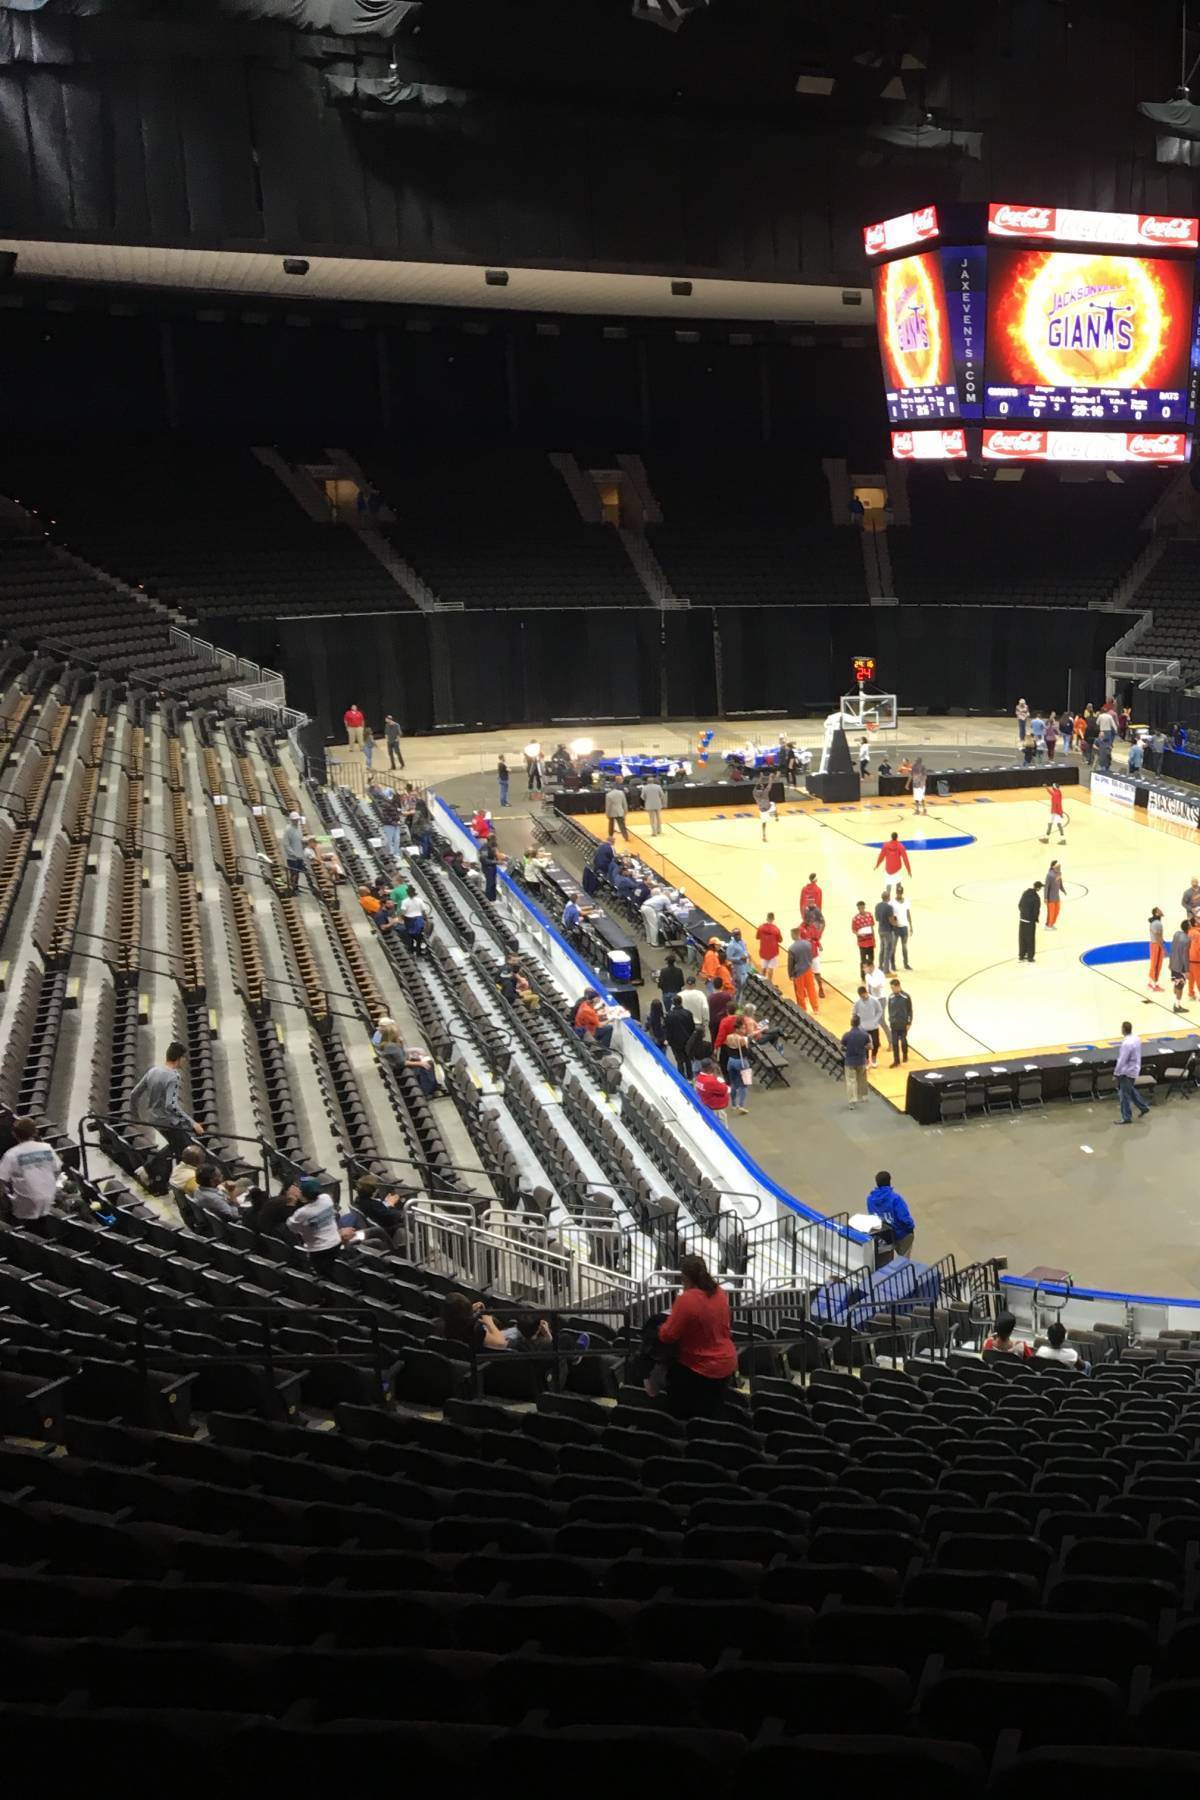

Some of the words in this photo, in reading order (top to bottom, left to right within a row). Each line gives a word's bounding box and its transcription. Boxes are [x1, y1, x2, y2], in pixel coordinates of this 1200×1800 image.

[1048, 303, 1132, 351] GIANTS
[999, 402, 1008, 414] 0
[1162, 407, 1170, 418] 0
[857, 668, 871, 680] 24
[1150, 792, 1200, 823] #JAXGIANTS
